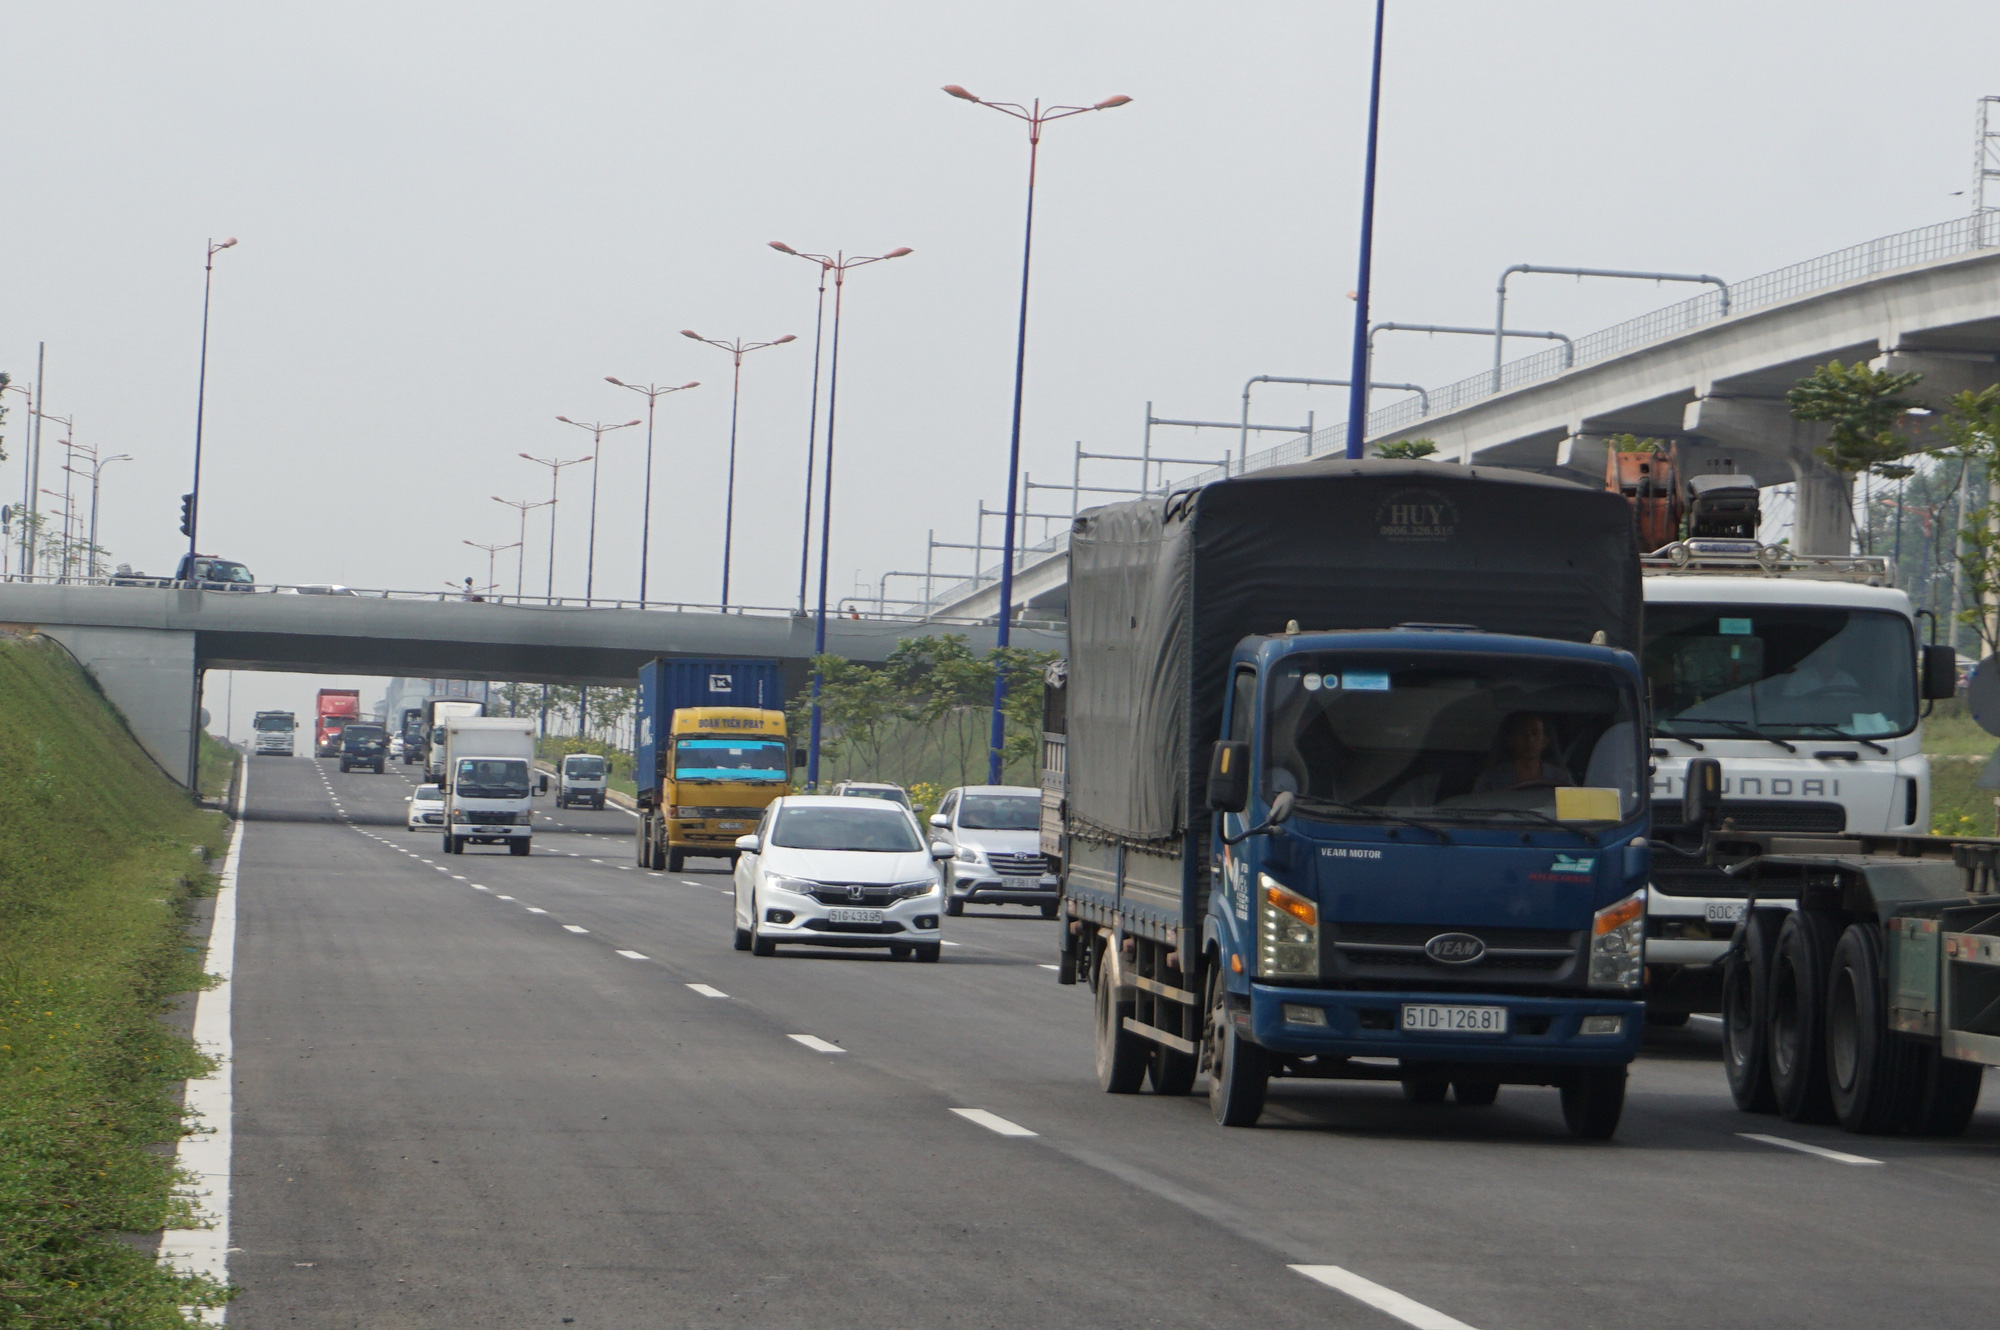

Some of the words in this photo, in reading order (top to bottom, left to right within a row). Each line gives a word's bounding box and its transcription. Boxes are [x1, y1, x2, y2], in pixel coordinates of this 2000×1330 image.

[1391, 504, 1444, 525] HUY
[1650, 776, 1840, 796] HNDAI
[1321, 847, 1347, 857] VEAM
[1349, 849, 1381, 859] MOTOR
[1433, 941, 1479, 956] VEAM
[1406, 1008, 1499, 1030] 51D-126.81
